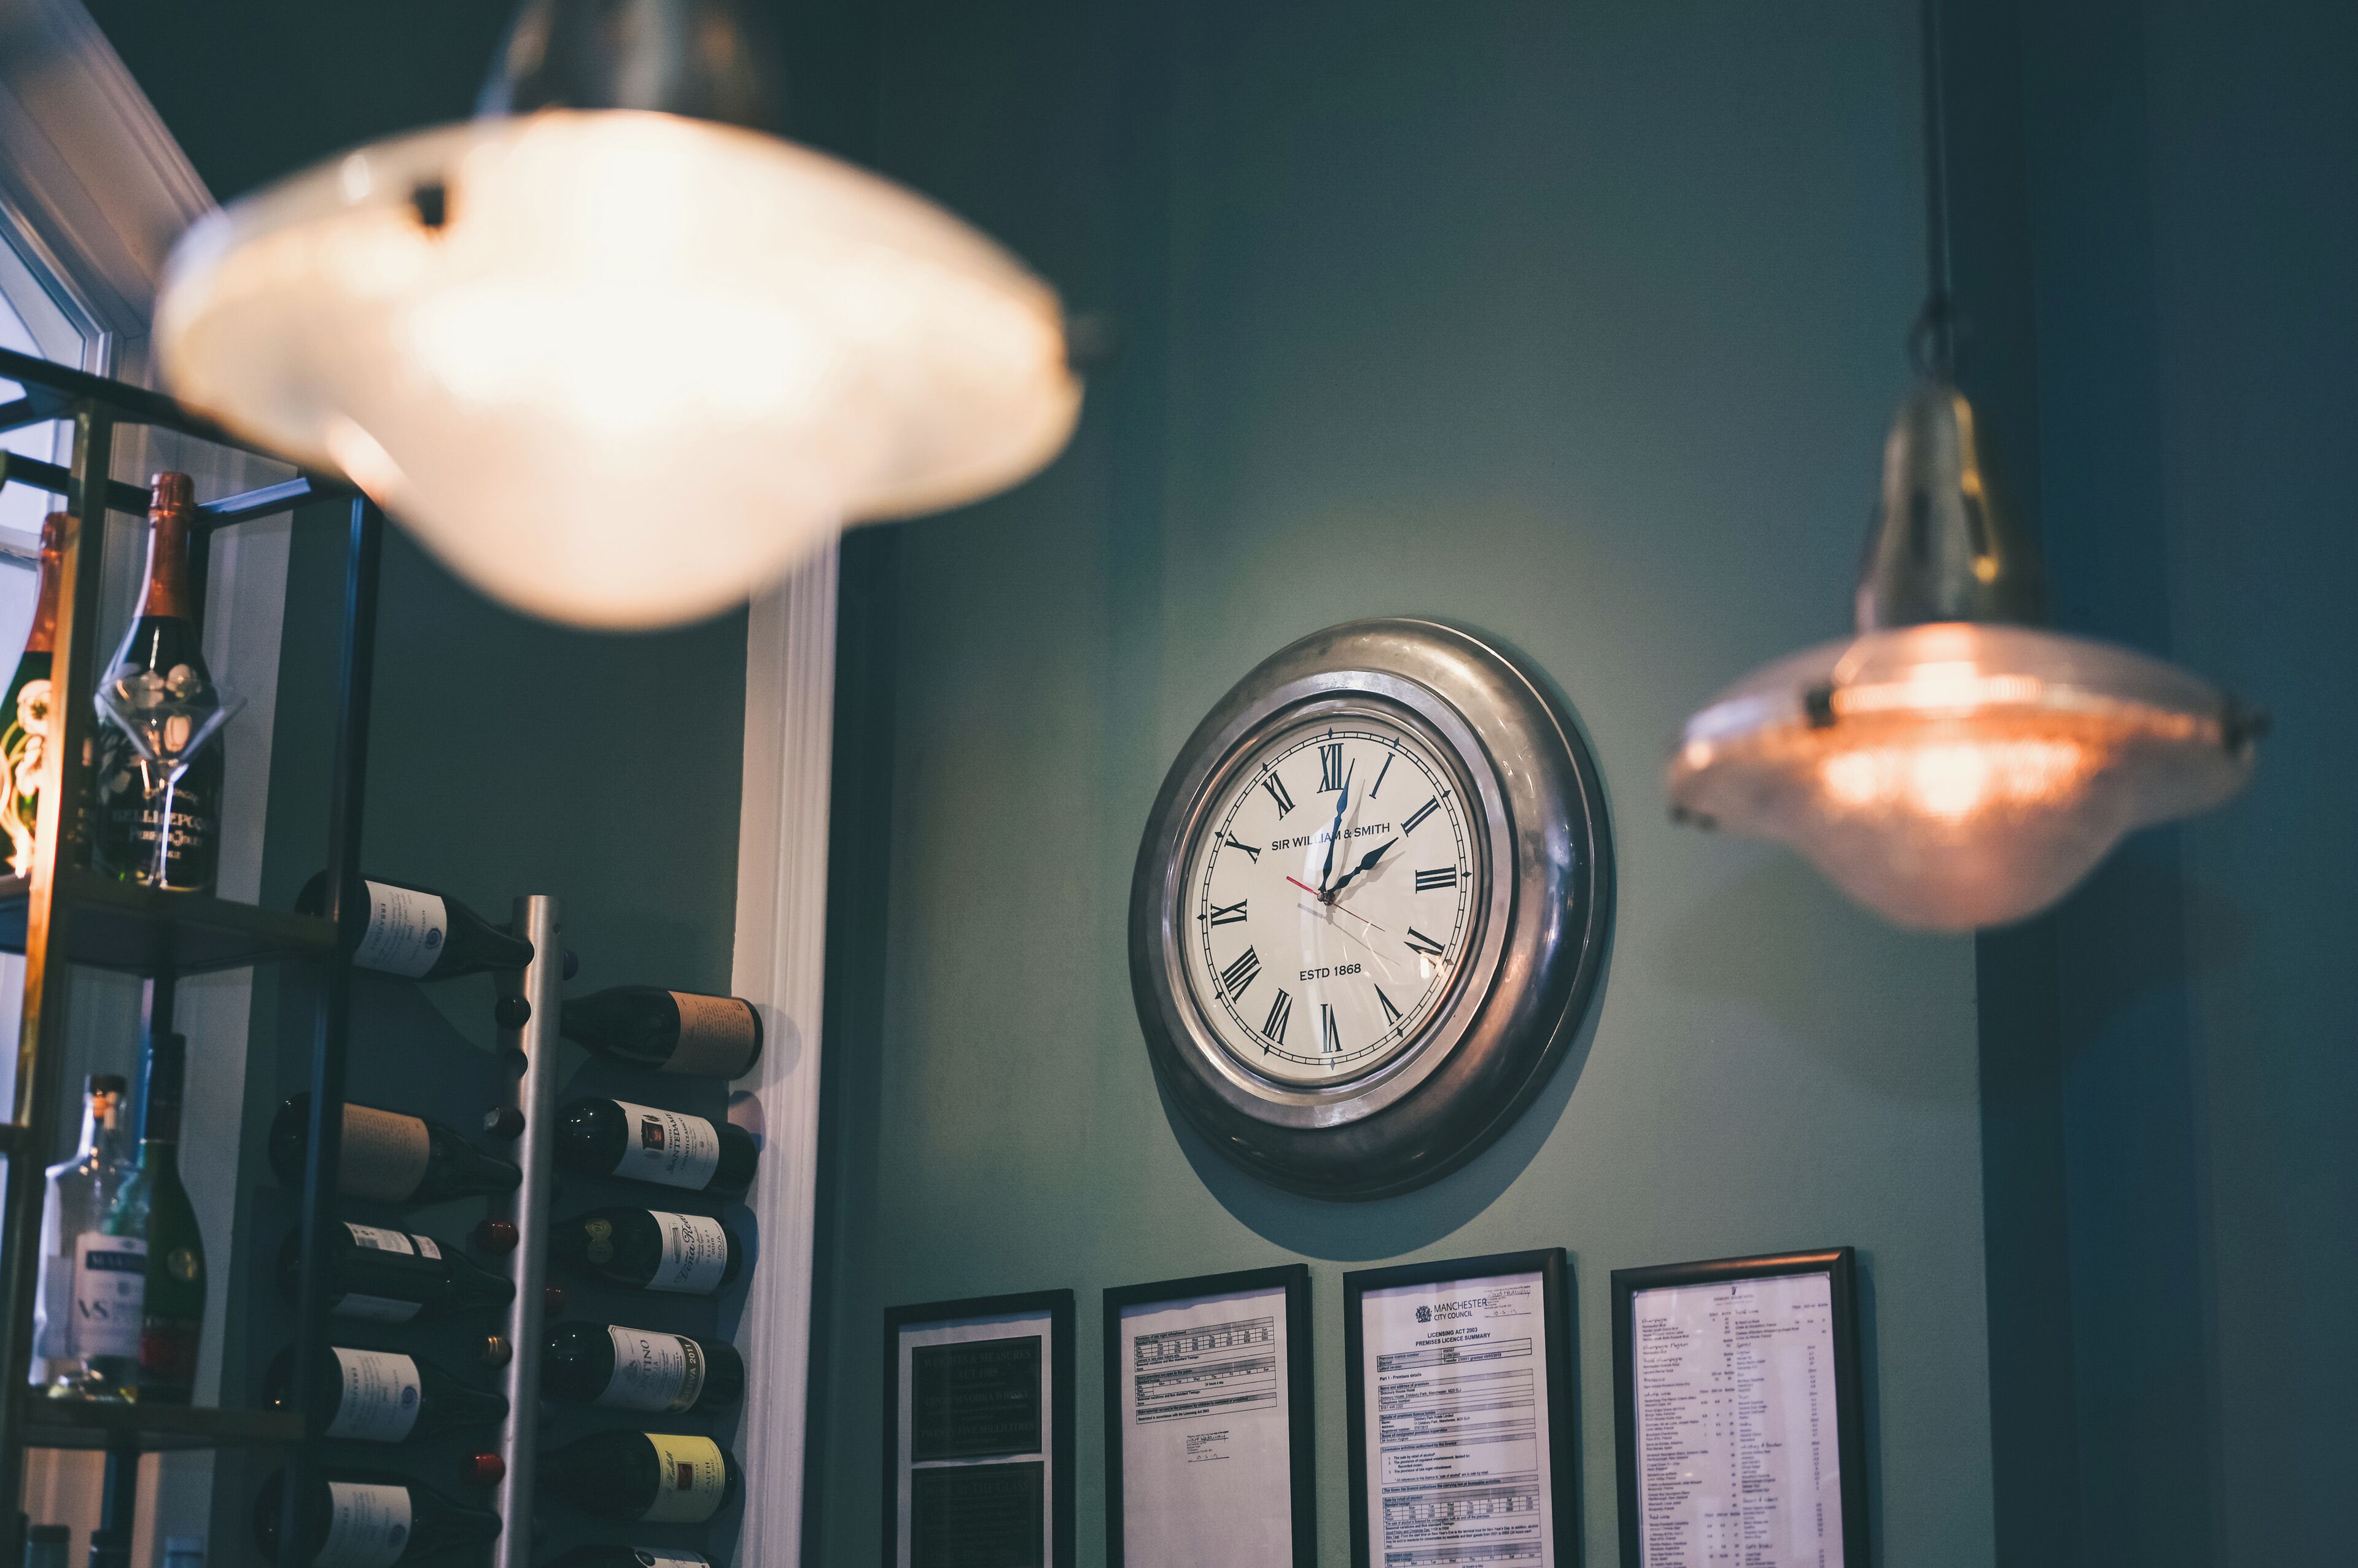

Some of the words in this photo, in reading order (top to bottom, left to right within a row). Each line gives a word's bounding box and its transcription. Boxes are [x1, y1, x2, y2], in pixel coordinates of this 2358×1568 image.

[1317, 743, 1345, 794] XII
[1369, 752, 1395, 799] I
[1261, 770, 1296, 821] XI
[1401, 795, 1441, 837] II
[1224, 830, 1262, 864] X
[1272, 840, 1290, 851] SIR
[1344, 829, 1352, 839] &
[1354, 823, 1390, 837] SMITH
[1415, 864, 1457, 894] III
[1210, 898, 1248, 929] IX
[1220, 944, 1263, 1004] VIII
[1299, 968, 1330, 981] ESTD
[1334, 963, 1362, 977] 1868
[1261, 987, 1293, 1046] VII
[1374, 983, 1404, 1027] V
[1321, 1003, 1343, 1054] VI
[674, 1244, 695, 1283] Viña
[1434, 1298, 1488, 1313] MANCHESTER
[1447, 1311, 1473, 1319] COUNCIL
[1415, 1338, 1441, 1346] PREMISES
[1428, 1330, 1454, 1338] LICENSING
[684, 1344, 696, 1364] 2011
